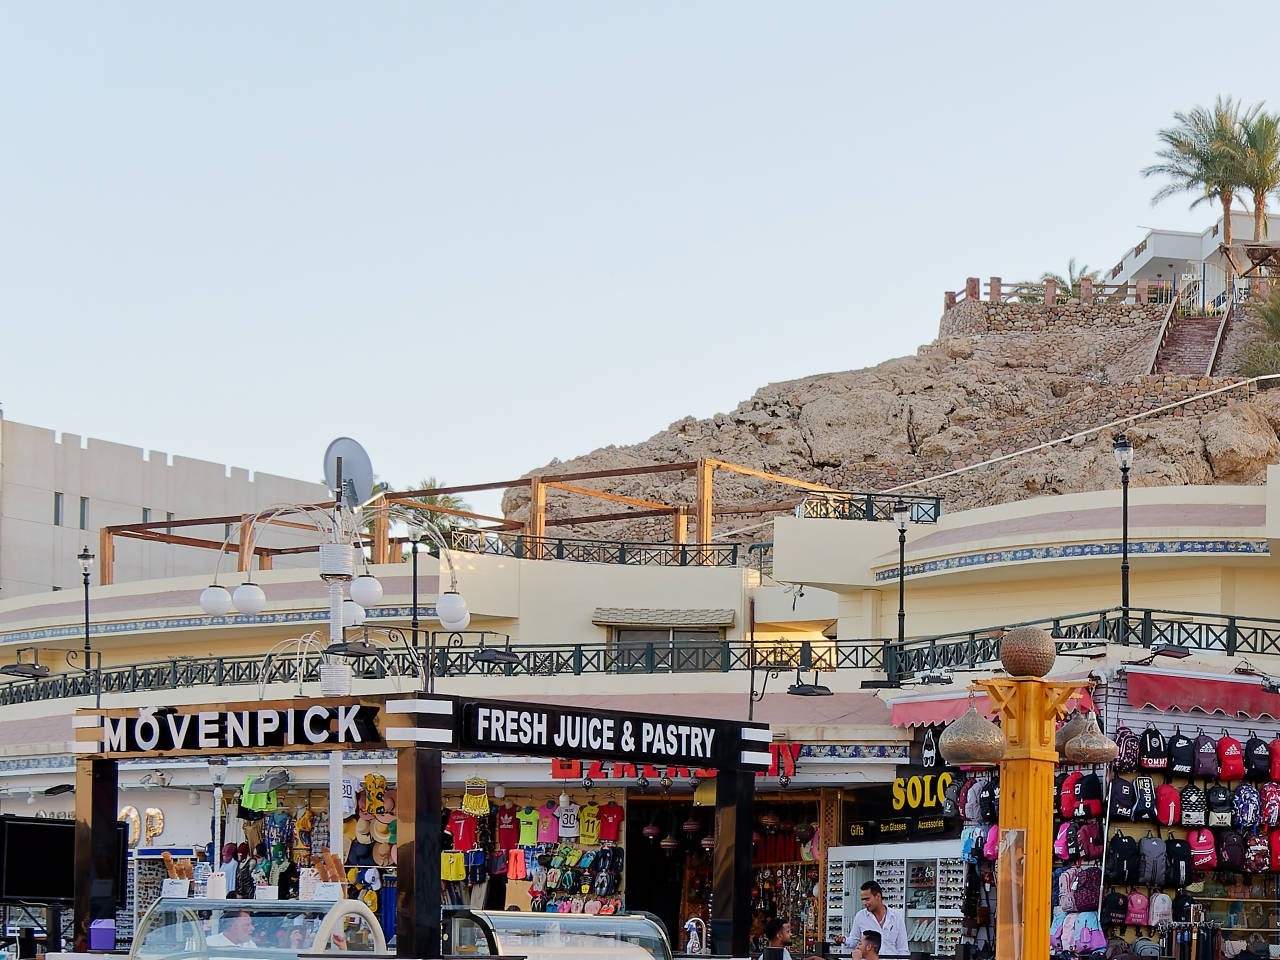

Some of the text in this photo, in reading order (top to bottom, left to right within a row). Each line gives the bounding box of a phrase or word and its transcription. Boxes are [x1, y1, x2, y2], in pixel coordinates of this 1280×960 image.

[477, 707, 716, 759] FRESH JUICE & PASTRY
[562, 813, 576, 825] 30
[917, 819, 944, 830] Accessories
[455, 820, 464, 840] 7
[584, 819, 596, 833] 11
[850, 824, 864, 837] Gifts
